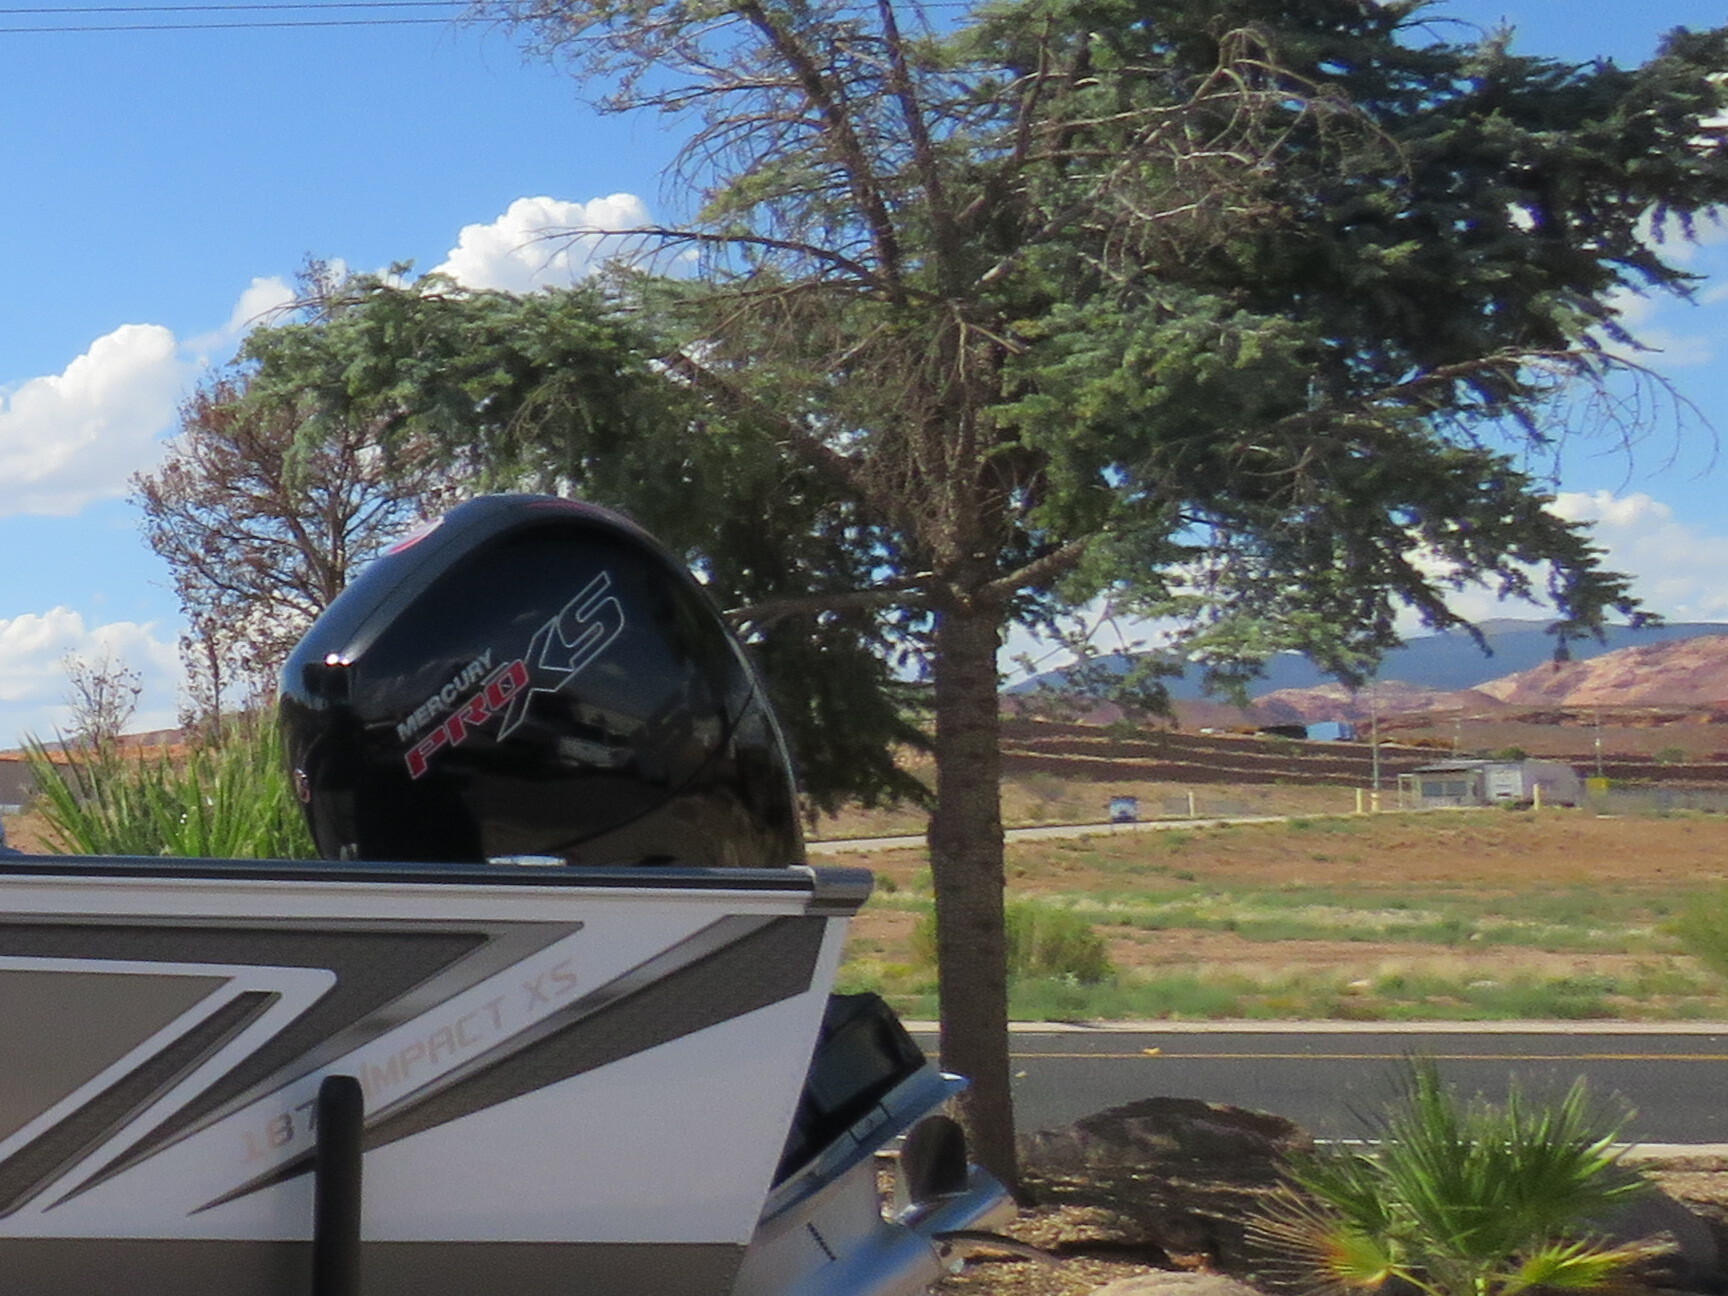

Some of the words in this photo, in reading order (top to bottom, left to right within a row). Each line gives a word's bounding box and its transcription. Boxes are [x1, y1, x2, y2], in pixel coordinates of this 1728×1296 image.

[396, 647, 492, 743] MERCURY
[404, 658, 530, 780] PRO
[242, 1095, 320, 1167] 187
[359, 994, 506, 1099] IMPACT
[521, 958, 579, 1011] XS
